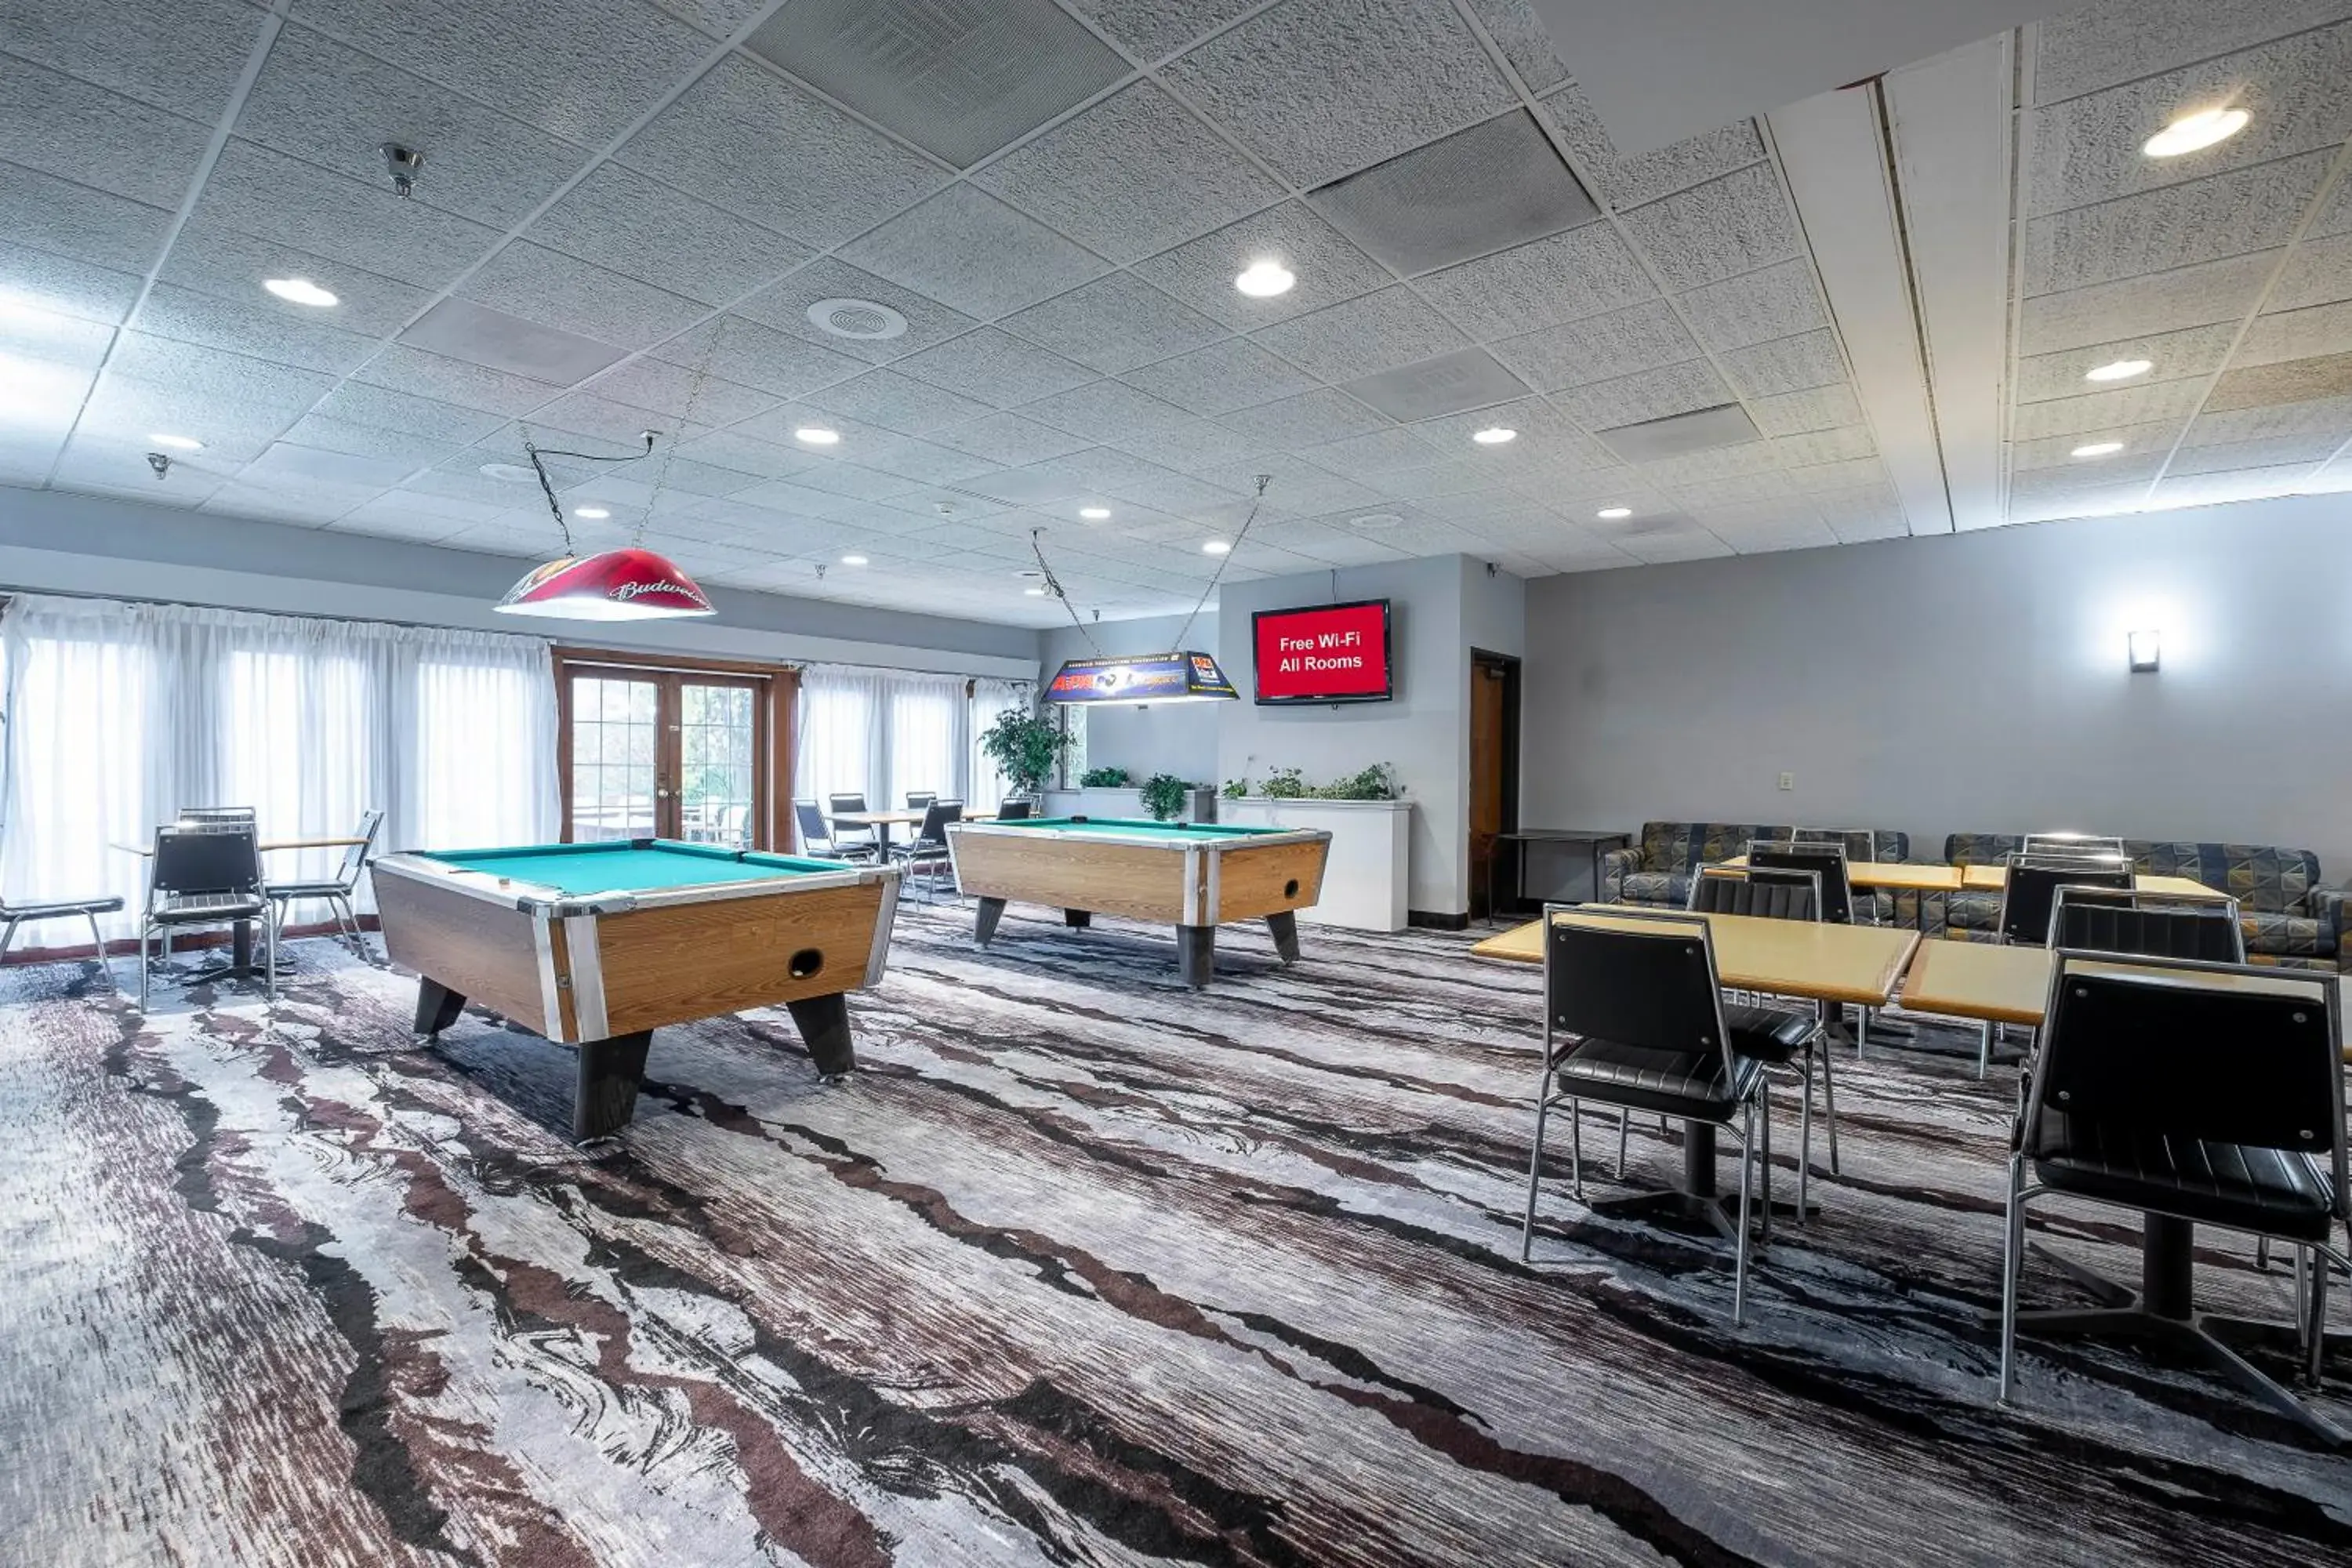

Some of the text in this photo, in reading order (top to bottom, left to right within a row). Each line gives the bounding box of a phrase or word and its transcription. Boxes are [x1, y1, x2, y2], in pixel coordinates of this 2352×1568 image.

[1279, 631, 1361, 652] Free Wi-Fi
[1279, 656, 1363, 672] All Rooms
